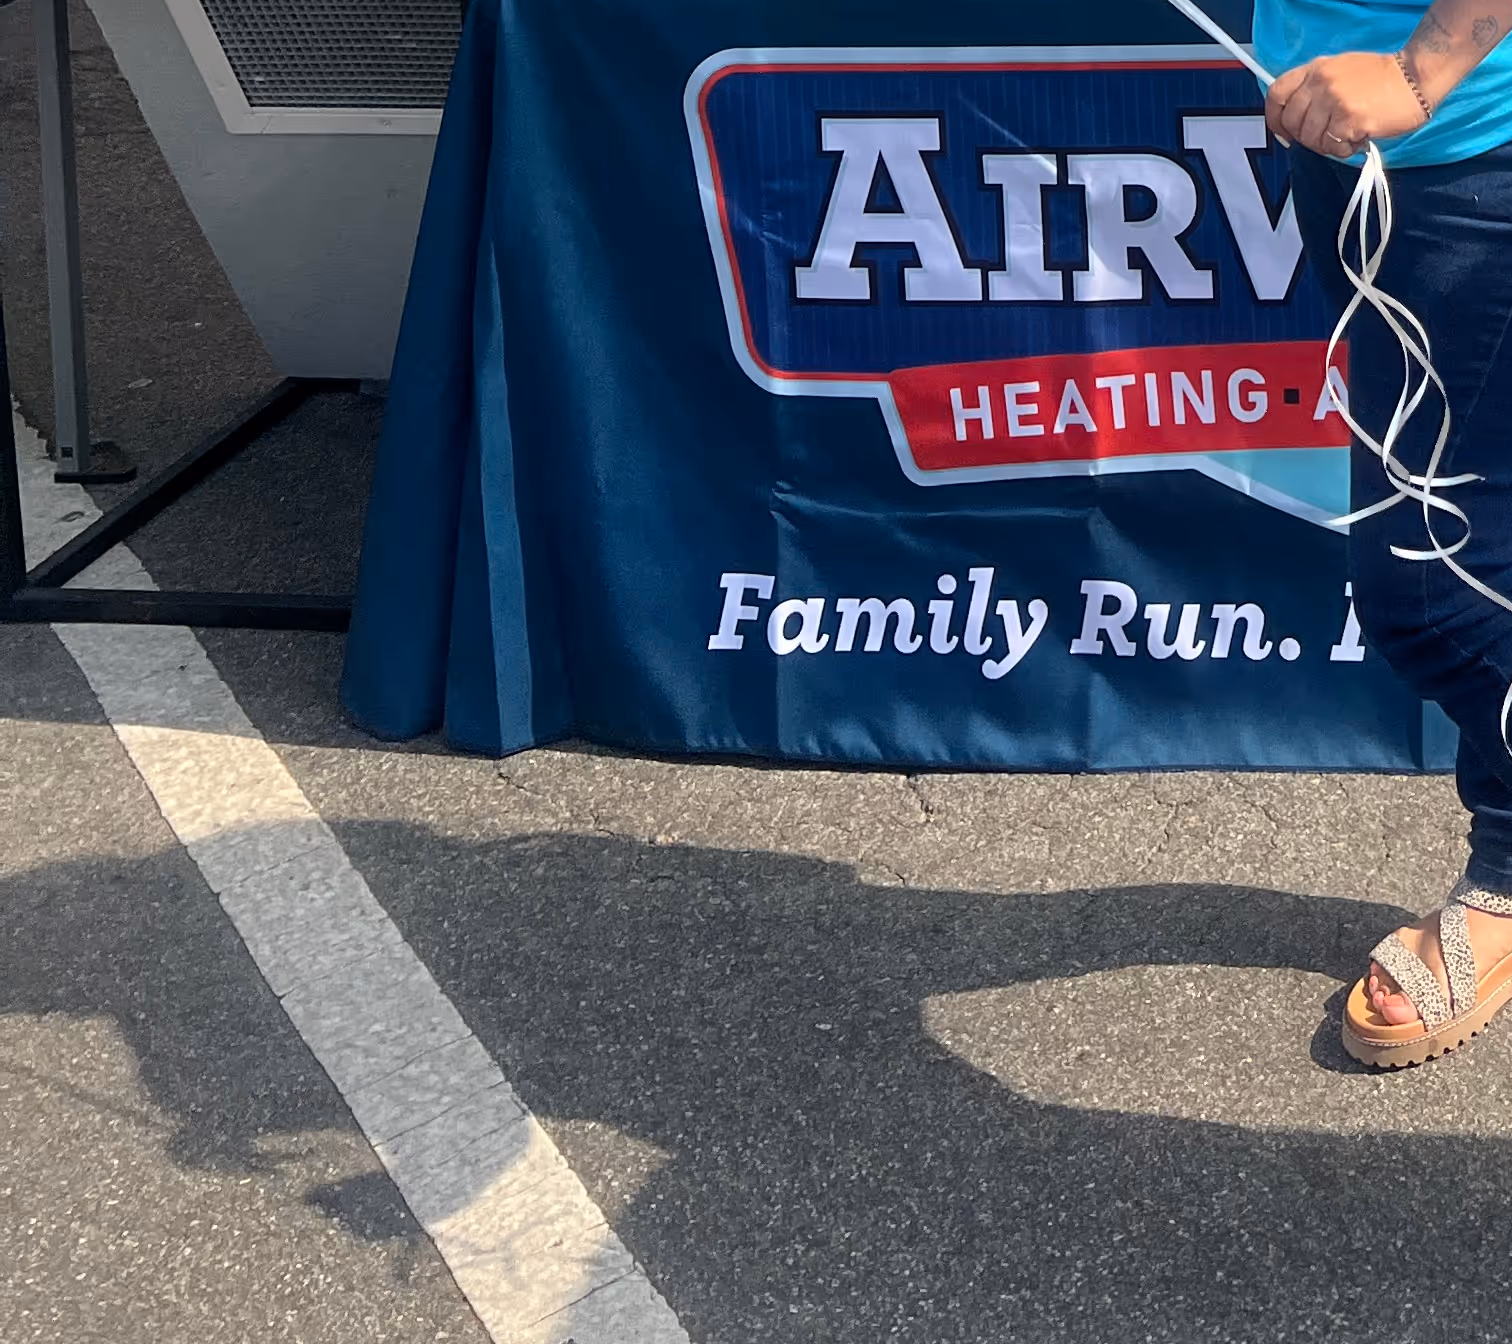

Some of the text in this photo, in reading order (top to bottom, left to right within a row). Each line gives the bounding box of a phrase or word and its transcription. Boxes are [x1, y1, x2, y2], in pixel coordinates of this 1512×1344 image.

[949, 367, 1267, 442] HEATING
[708, 567, 1048, 680] Family
[1069, 578, 1303, 663] Run.
